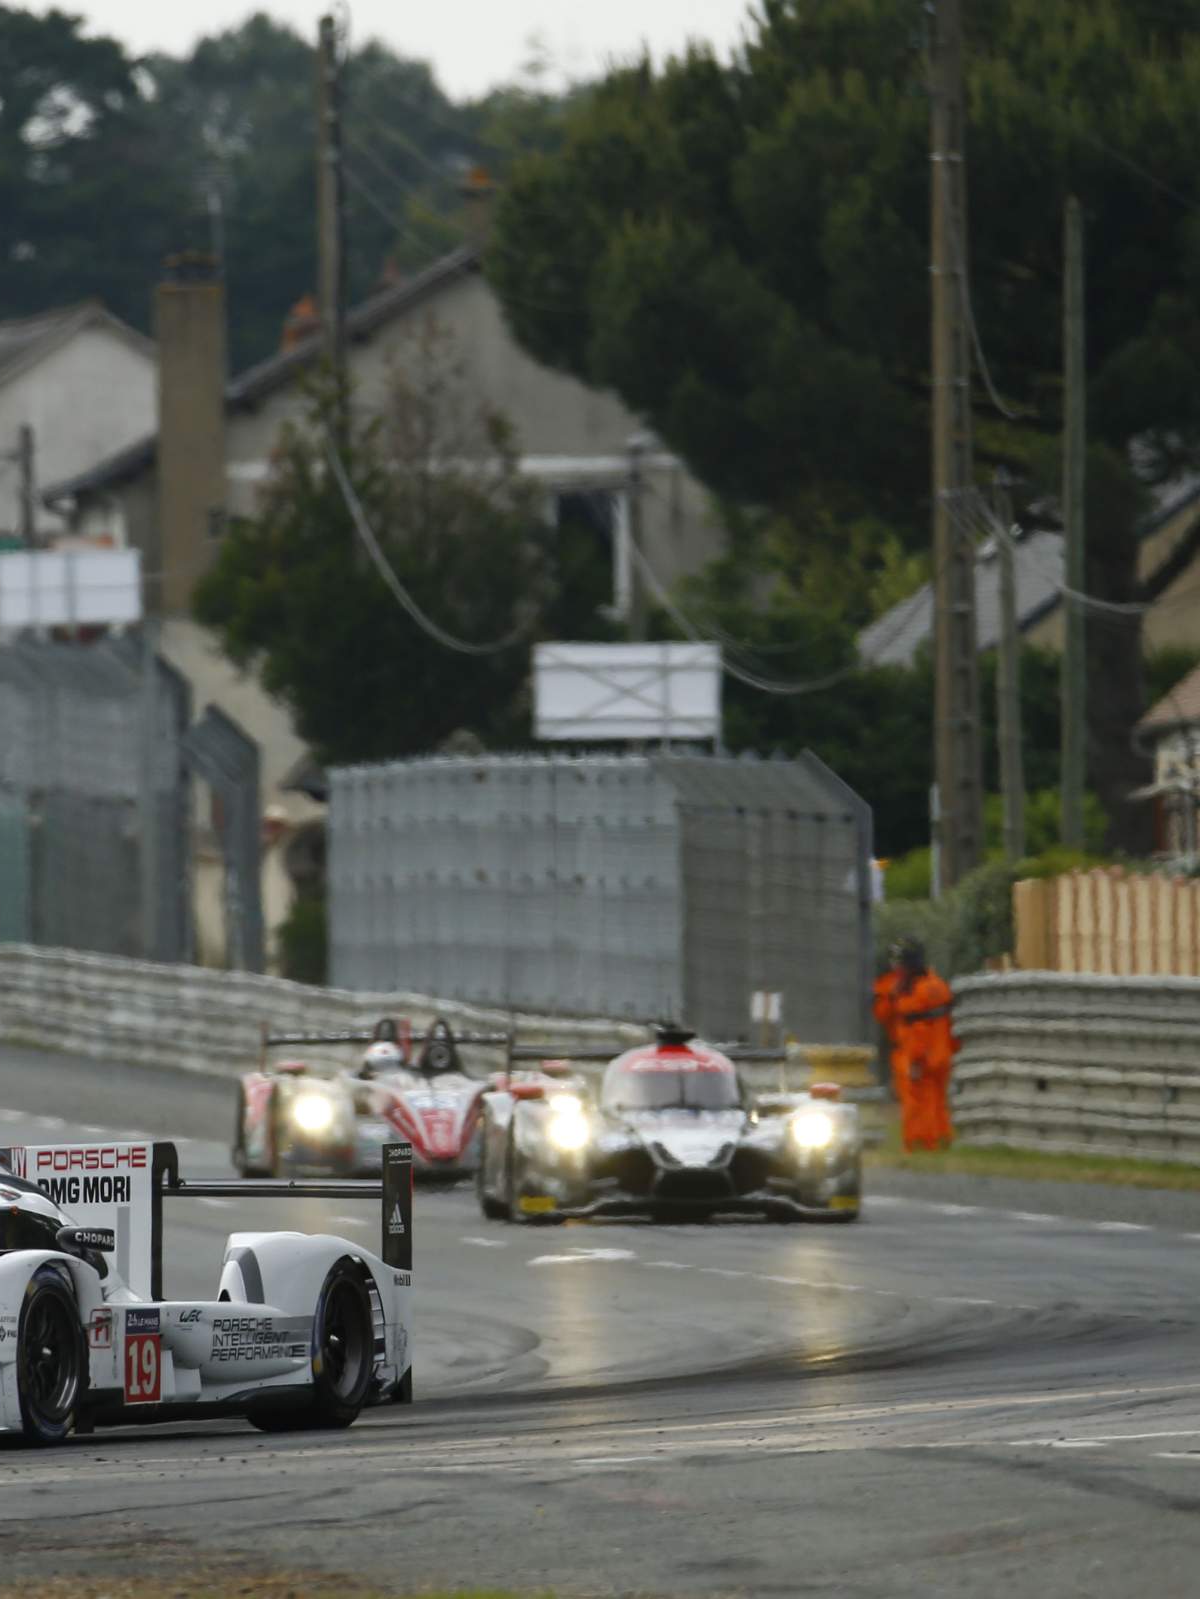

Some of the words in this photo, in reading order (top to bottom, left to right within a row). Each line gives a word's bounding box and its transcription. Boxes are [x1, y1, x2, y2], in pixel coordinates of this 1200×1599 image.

[36, 1147, 147, 1171] PORSCHE
[83, 1175, 132, 1204] MORI
[212, 1317, 273, 1332] PORSCHE
[212, 1331, 289, 1347] INTELLIGENT
[127, 1340, 158, 1396] 19
